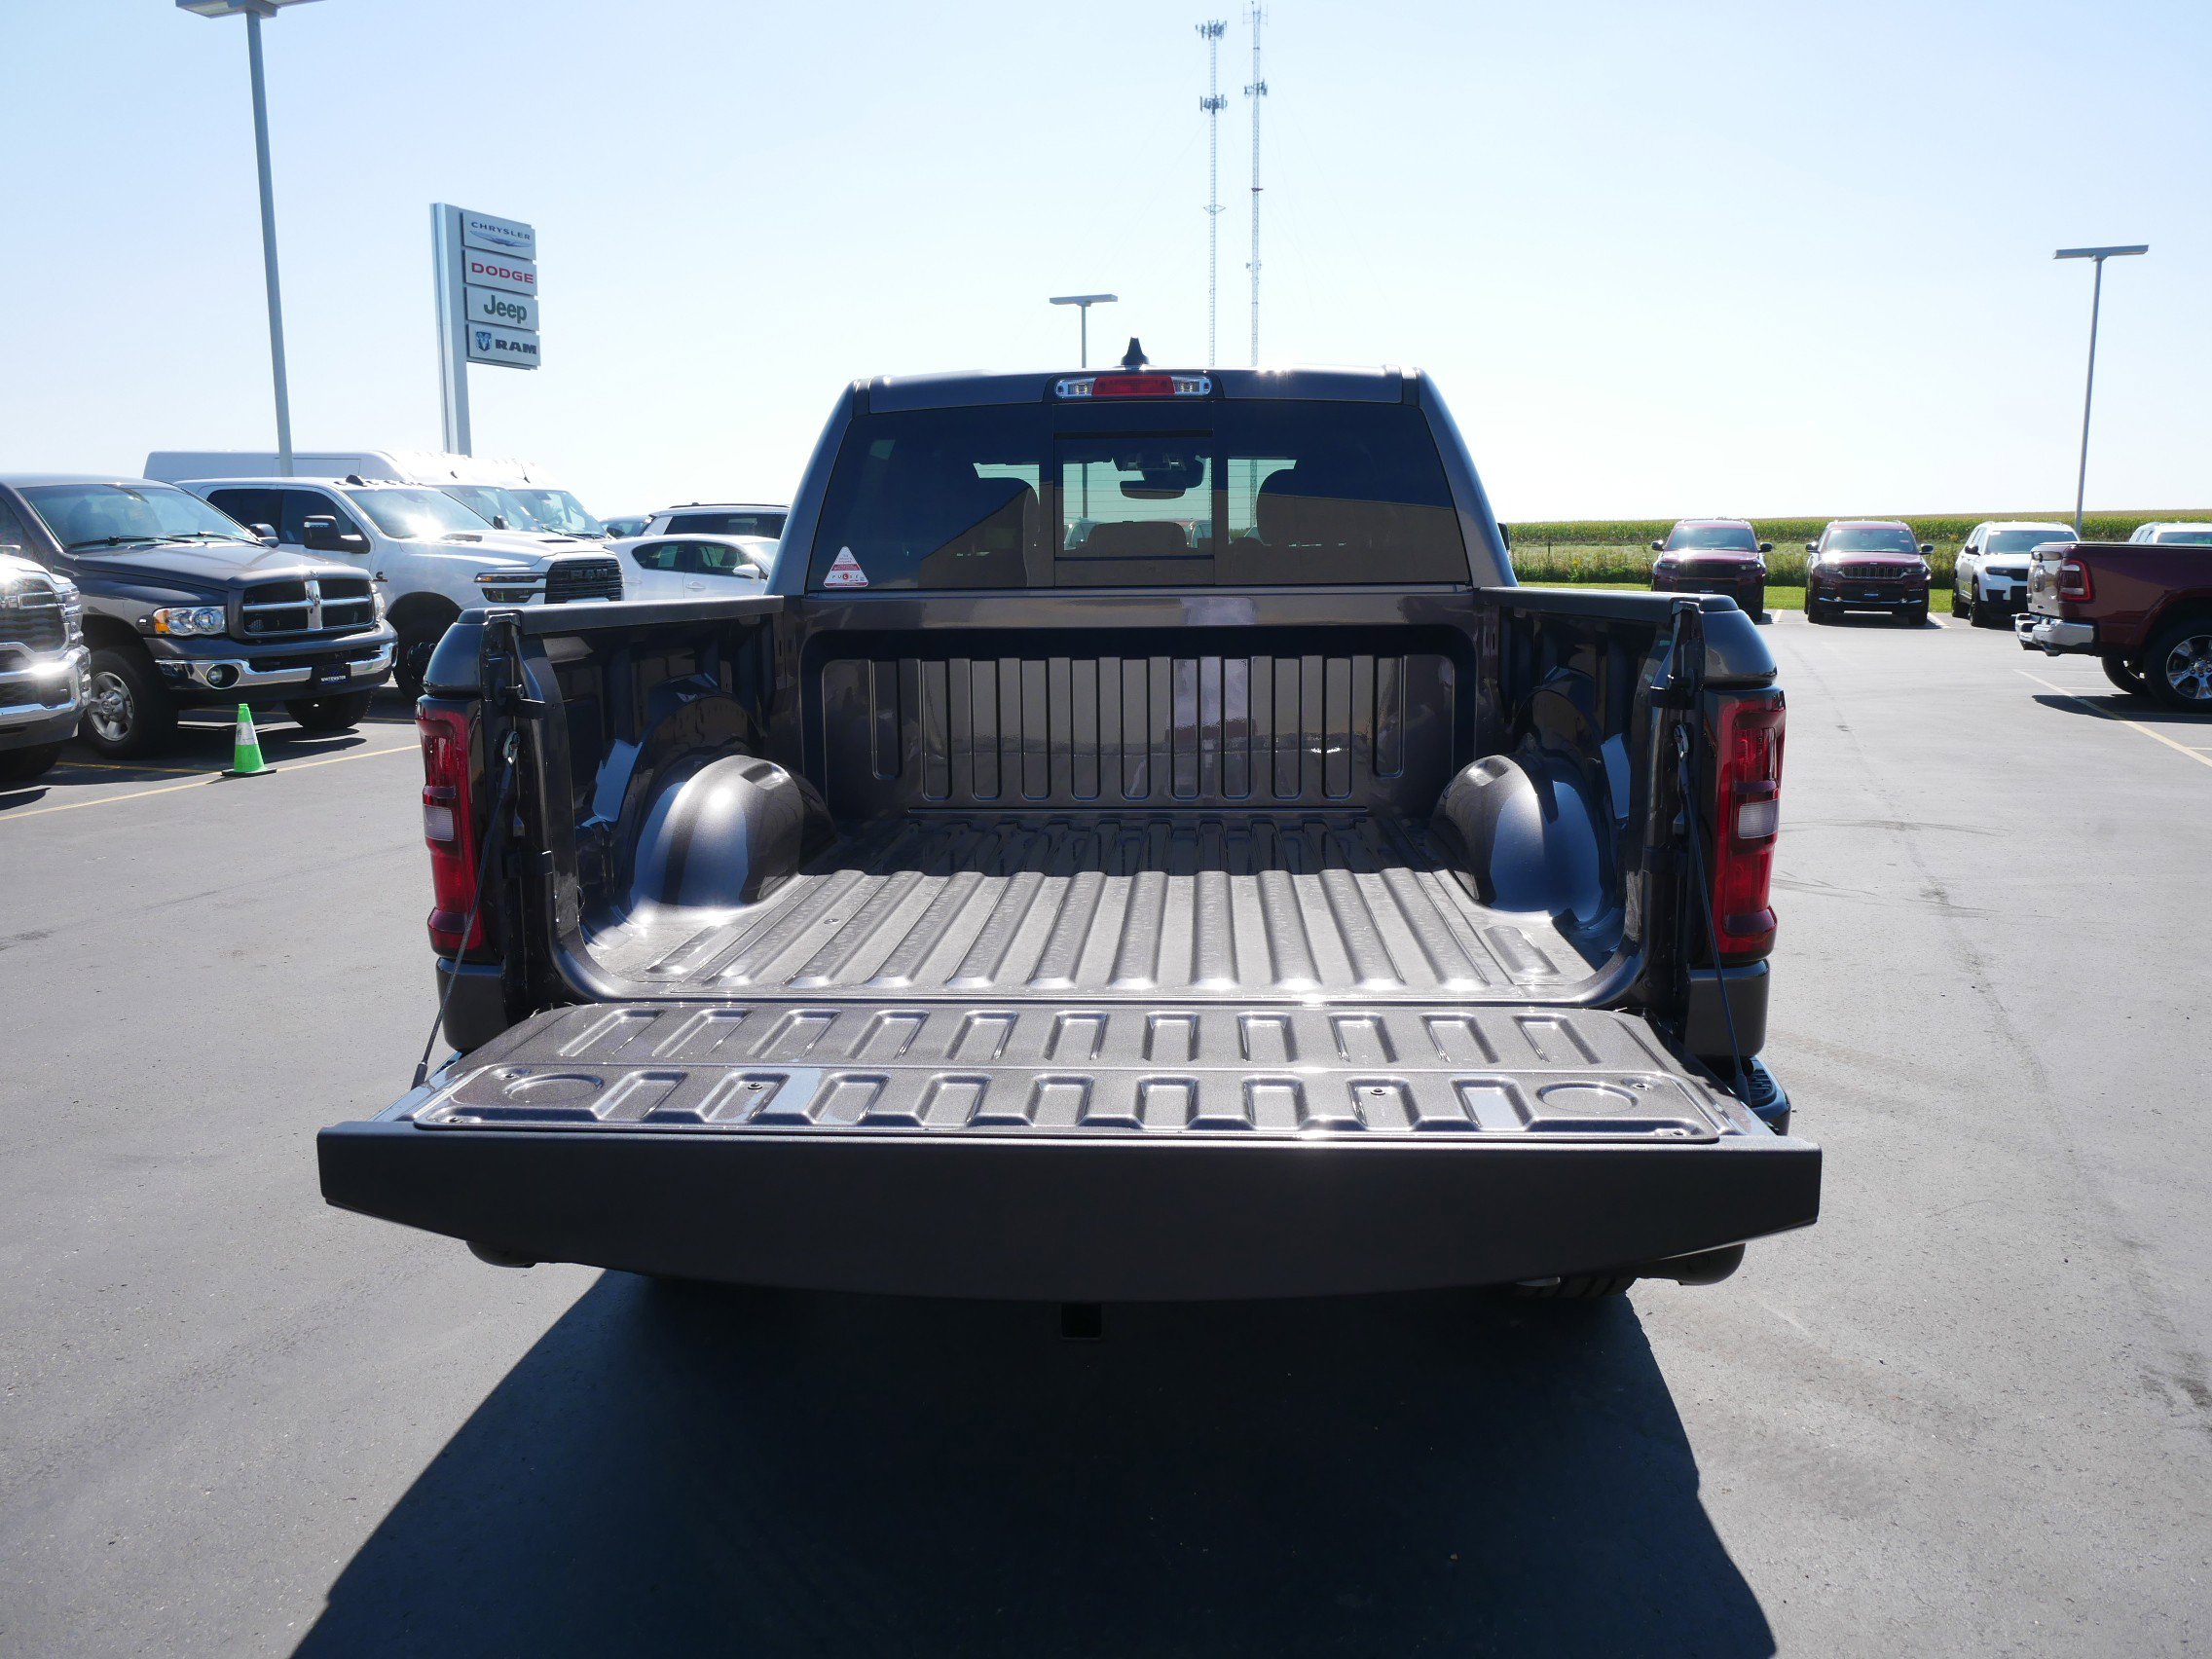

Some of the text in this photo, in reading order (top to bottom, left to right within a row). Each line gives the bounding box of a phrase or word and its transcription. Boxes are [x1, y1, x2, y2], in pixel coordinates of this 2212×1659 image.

[471, 222, 531, 240] CHRYSLER
[471, 263, 534, 283] DODGE
[484, 295, 528, 324] Jeep
[496, 339, 537, 354] RAM
